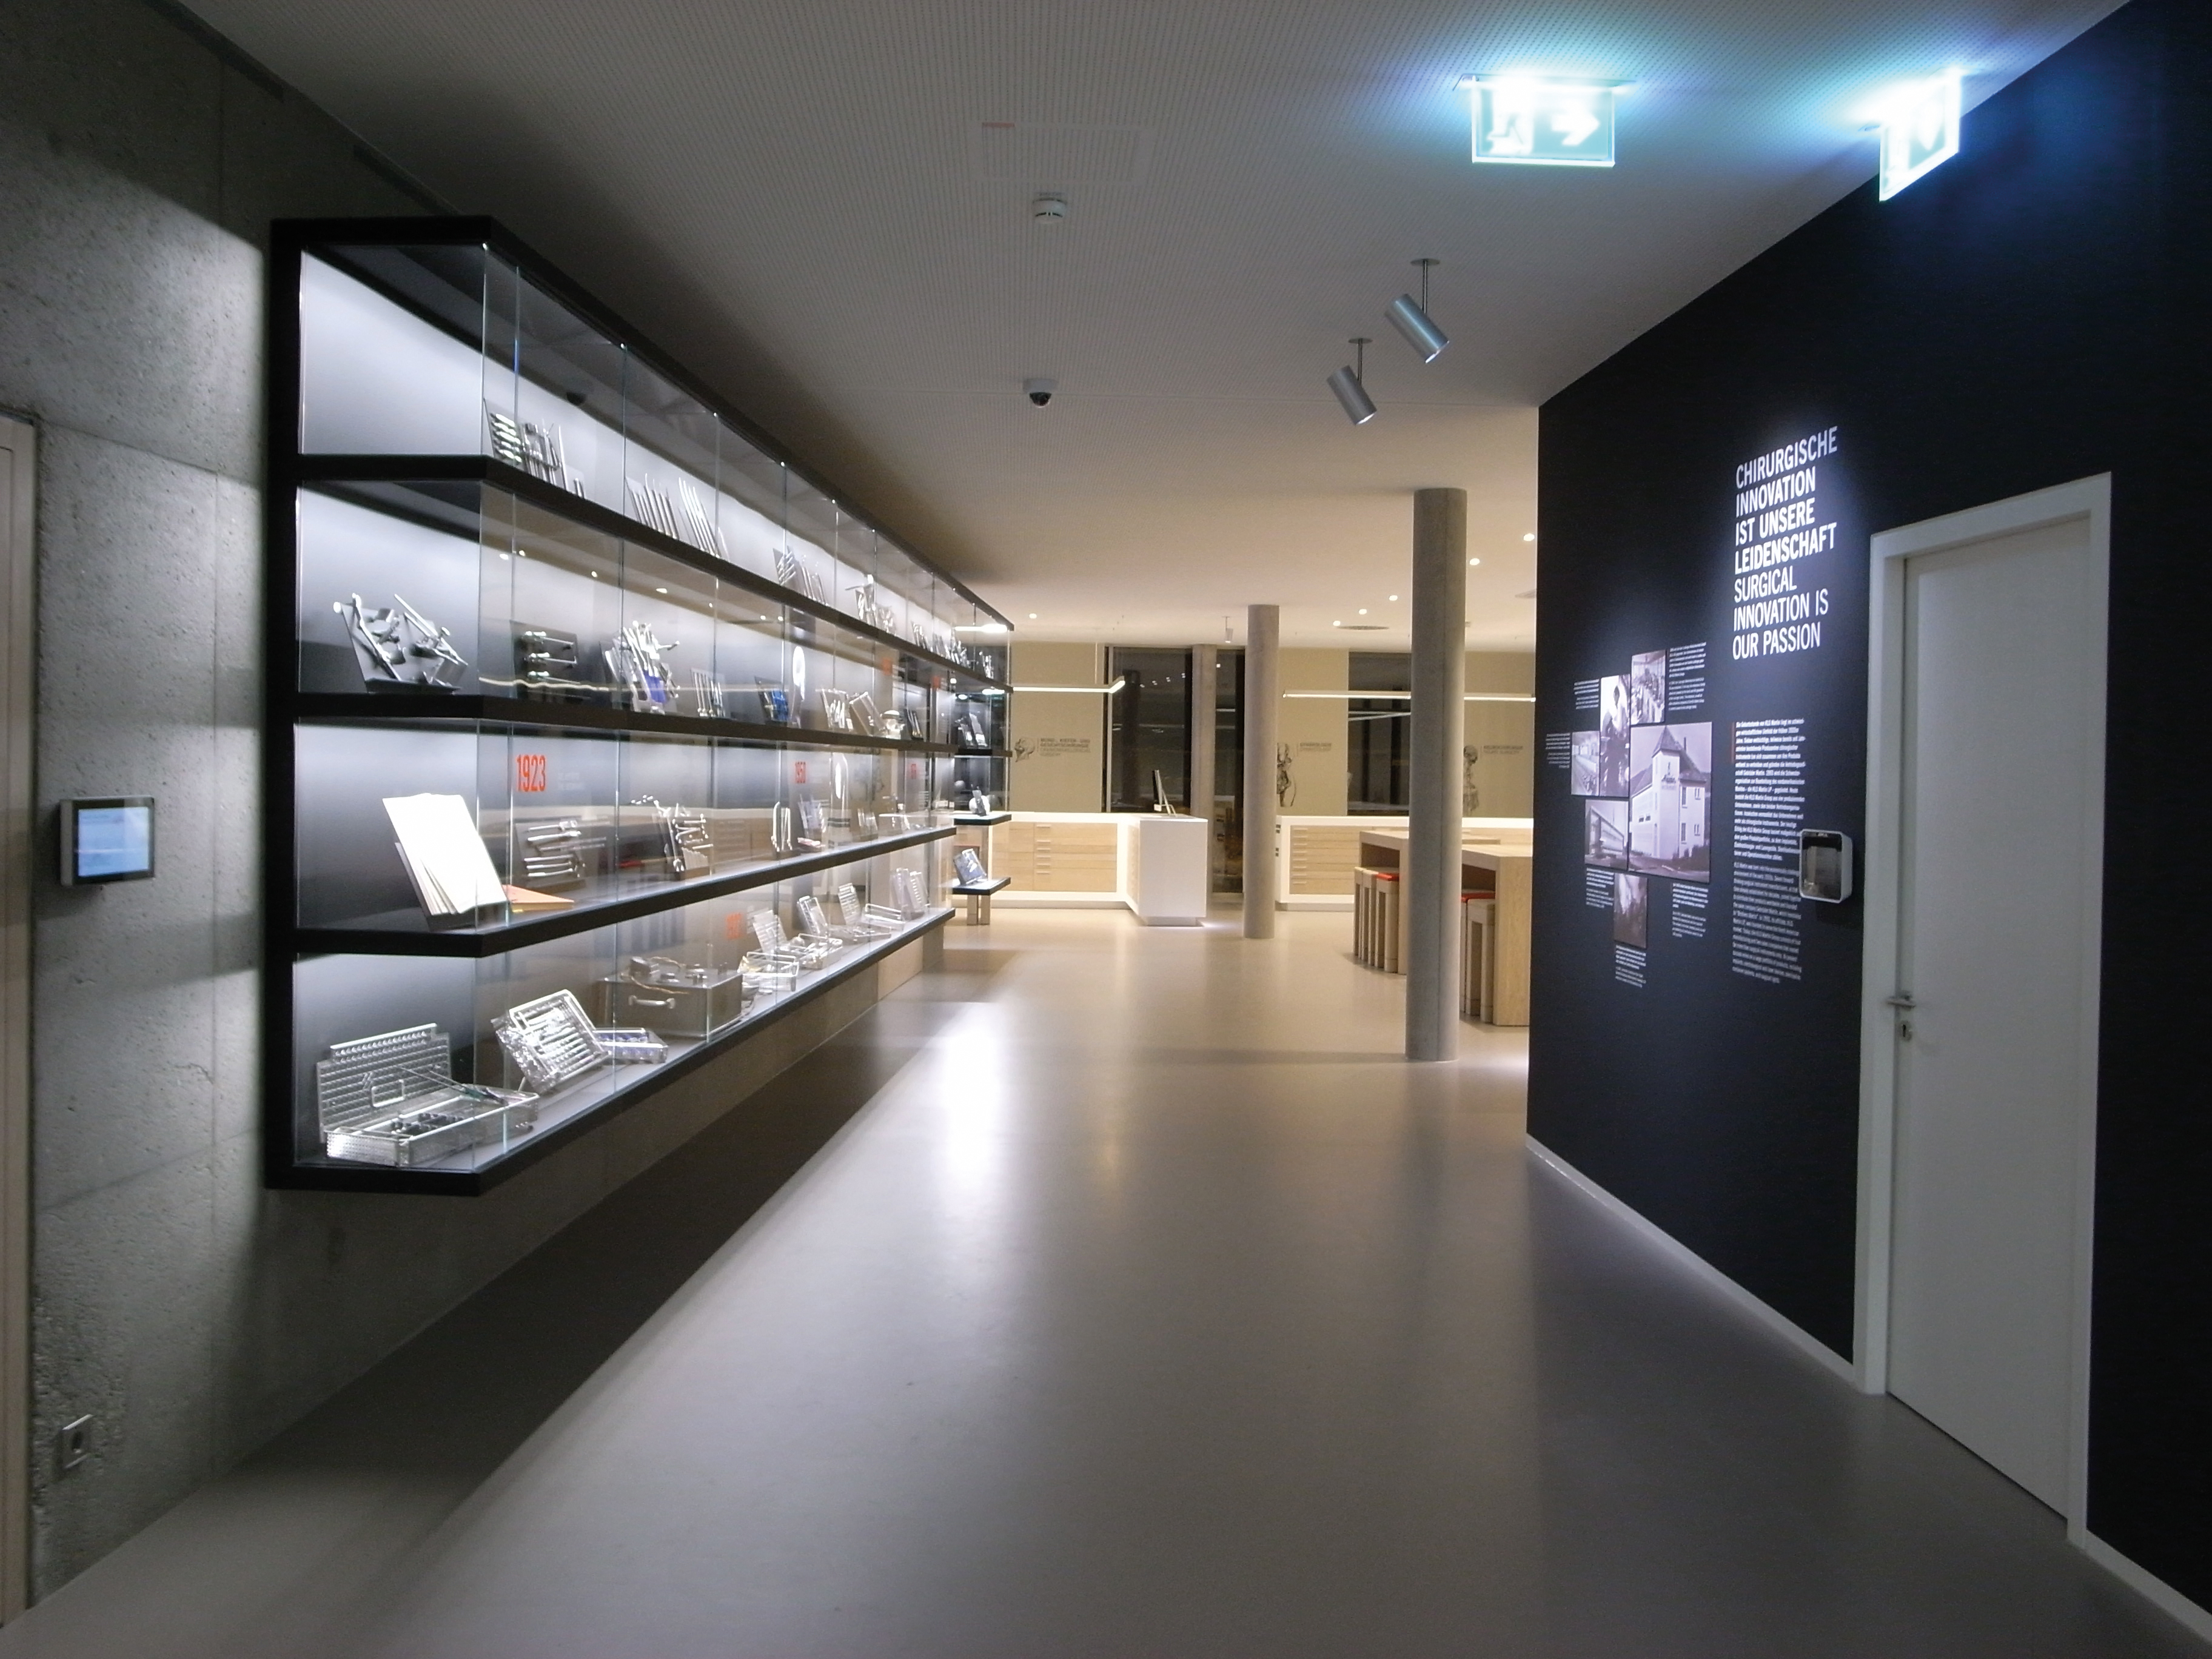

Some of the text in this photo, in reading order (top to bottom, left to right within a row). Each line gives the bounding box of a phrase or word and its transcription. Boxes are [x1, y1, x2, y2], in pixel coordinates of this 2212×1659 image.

[1736, 426, 1838, 489] CHIRURGISCHE
[1736, 466, 1816, 518] INNOVATION
[1735, 497, 1815, 546] IST UNSERE
[1735, 522, 1837, 575] LEIDENSCHAFT
[1734, 565, 1797, 603] SURGICAL
[1734, 588, 1829, 632] INNOVATION IS
[1732, 632, 1758, 660] OUR
[1763, 622, 1821, 655] PASSION
[517, 754, 546, 791] 1923
